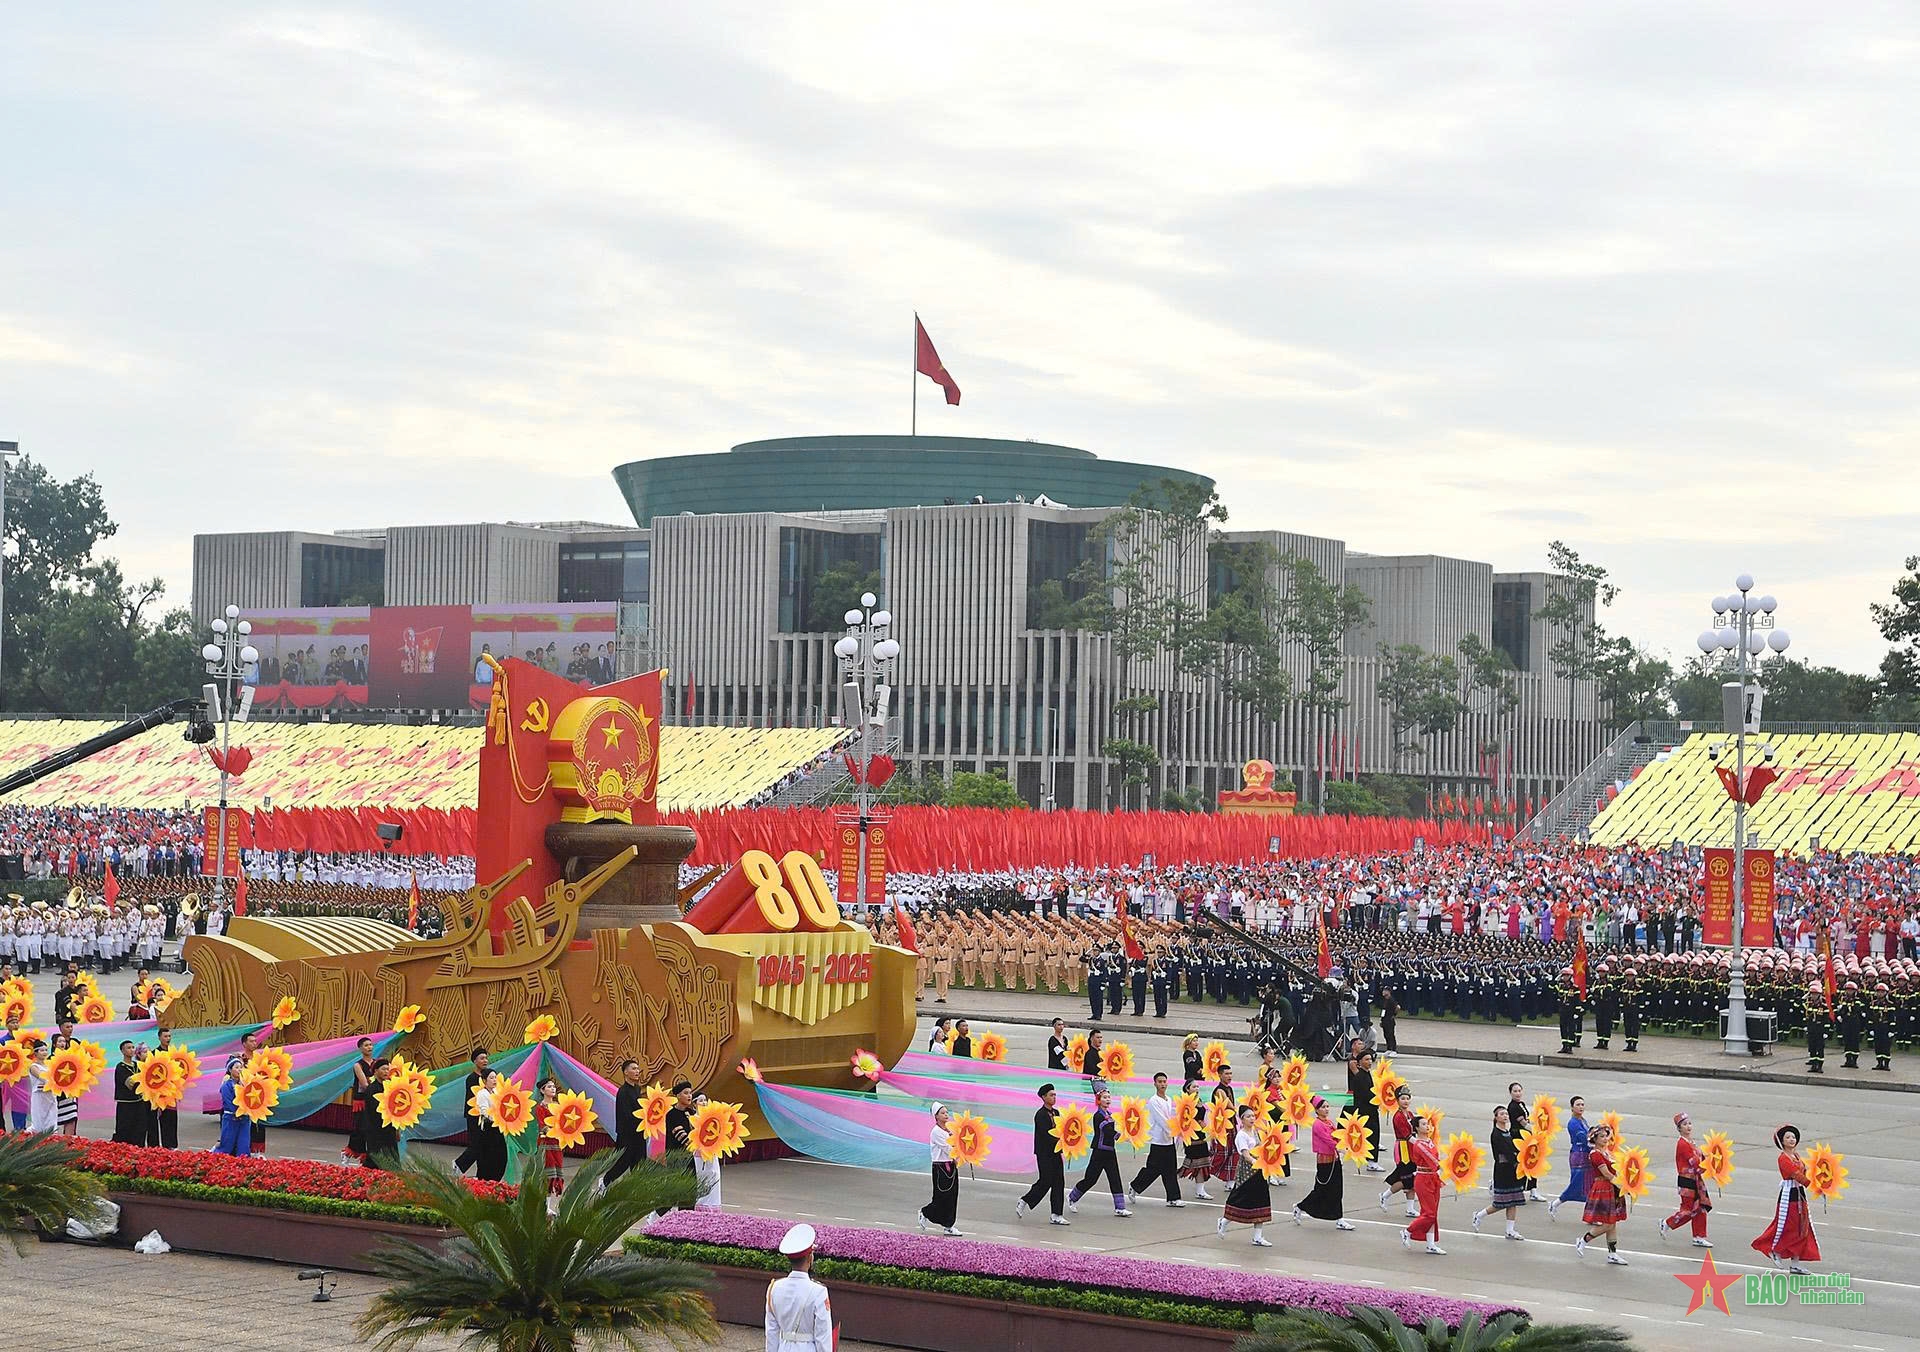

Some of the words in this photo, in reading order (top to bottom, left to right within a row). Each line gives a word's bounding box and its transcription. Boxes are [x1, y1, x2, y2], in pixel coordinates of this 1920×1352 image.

[741, 849, 840, 930] 80
[756, 954, 806, 987] 1945
[823, 953, 873, 985] 2025
